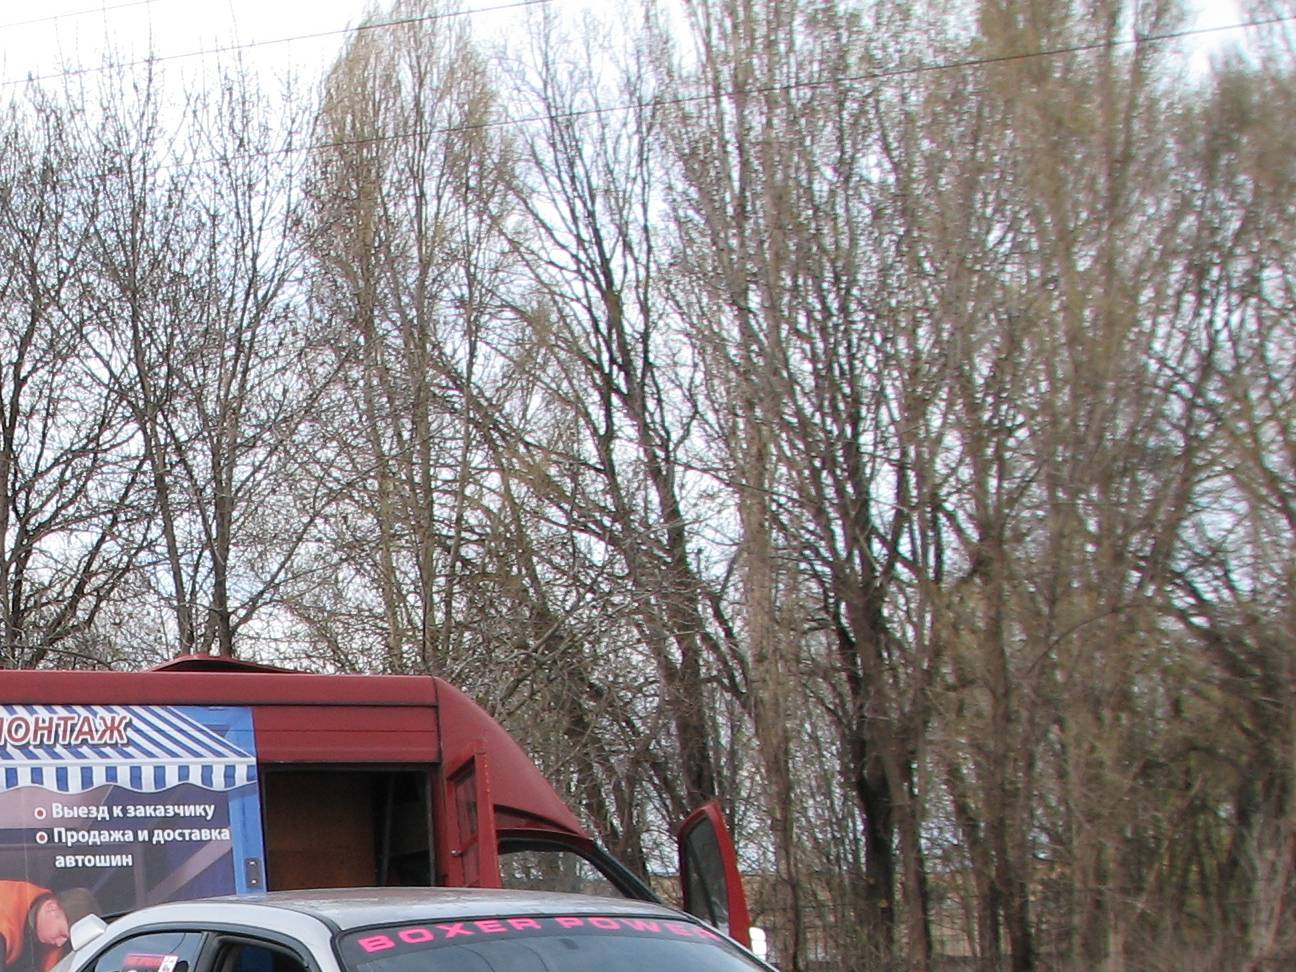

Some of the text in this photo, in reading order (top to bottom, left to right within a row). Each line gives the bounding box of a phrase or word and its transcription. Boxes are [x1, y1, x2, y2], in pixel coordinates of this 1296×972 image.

[52, 802, 215, 820] Выезд к заказчику
[54, 827, 231, 846] Продажа и доставка
[55, 854, 133, 868] автошин
[357, 917, 721, 953] BOXER POWER
